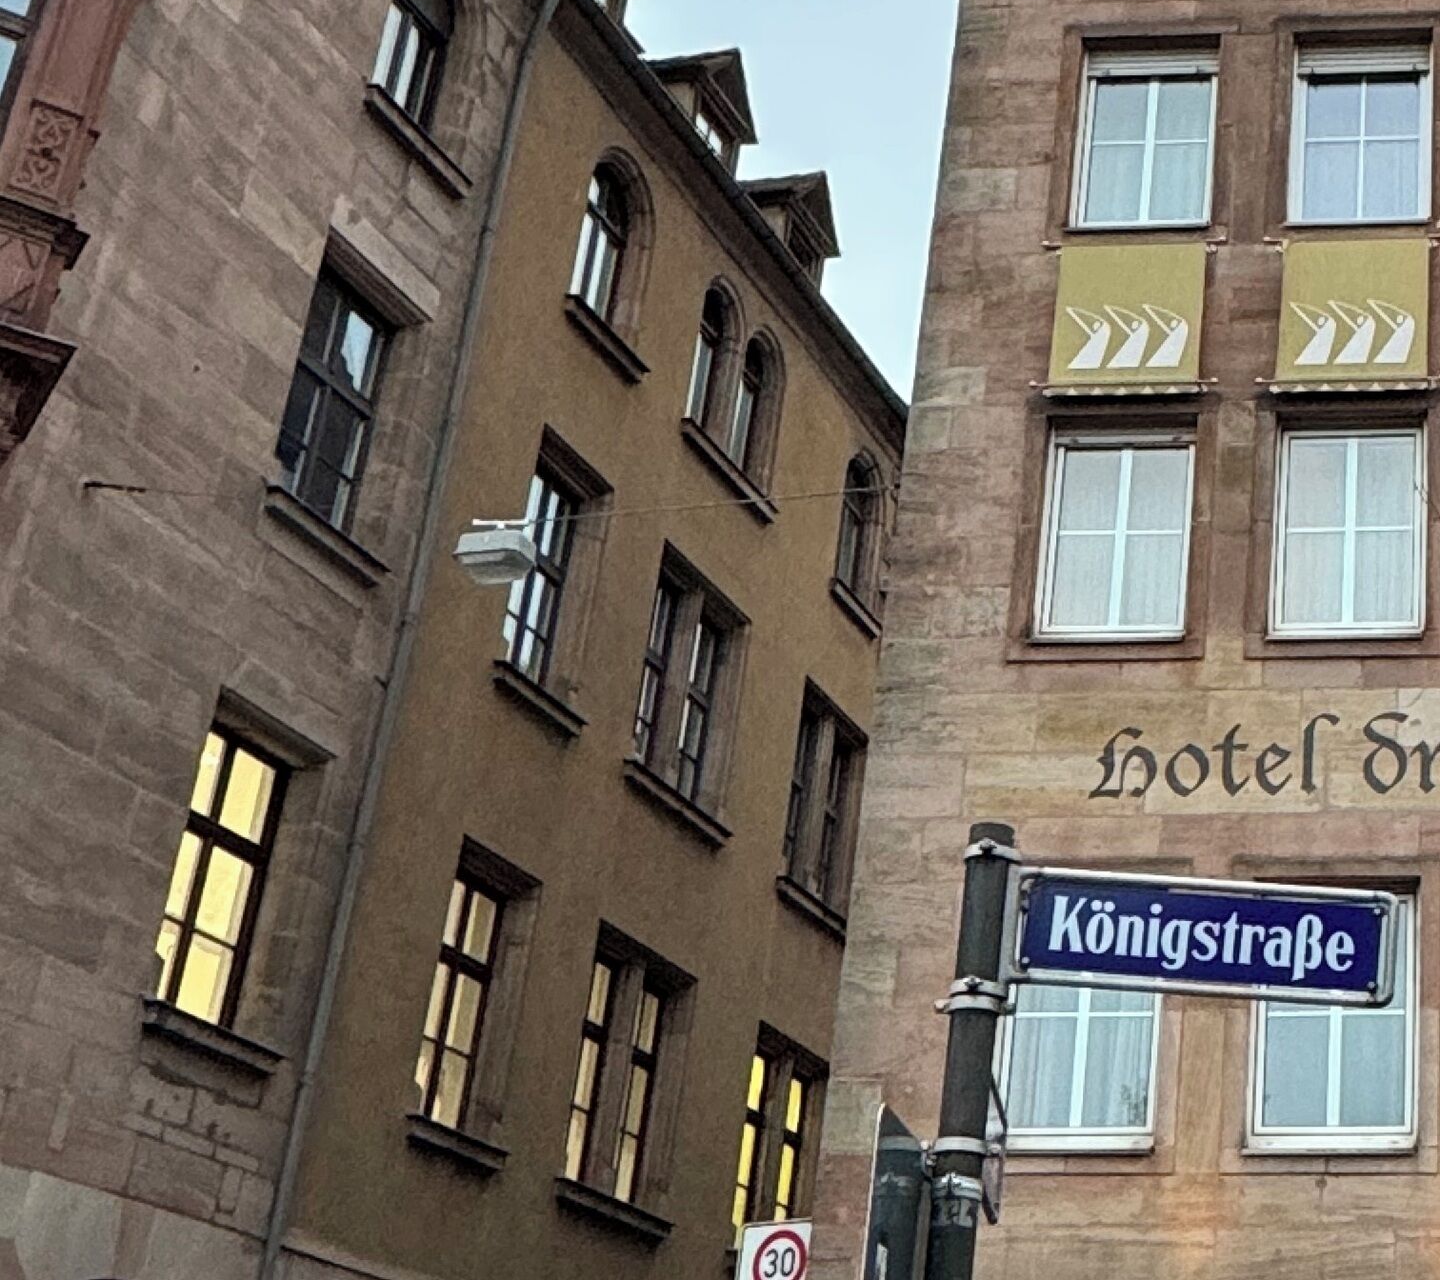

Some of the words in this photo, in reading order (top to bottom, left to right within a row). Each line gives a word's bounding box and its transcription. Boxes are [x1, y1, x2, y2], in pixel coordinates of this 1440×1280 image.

[1088, 712, 1341, 800] Hotel
[1047, 894, 1356, 982] Königstraße
[764, 1247, 796, 1279] 30
